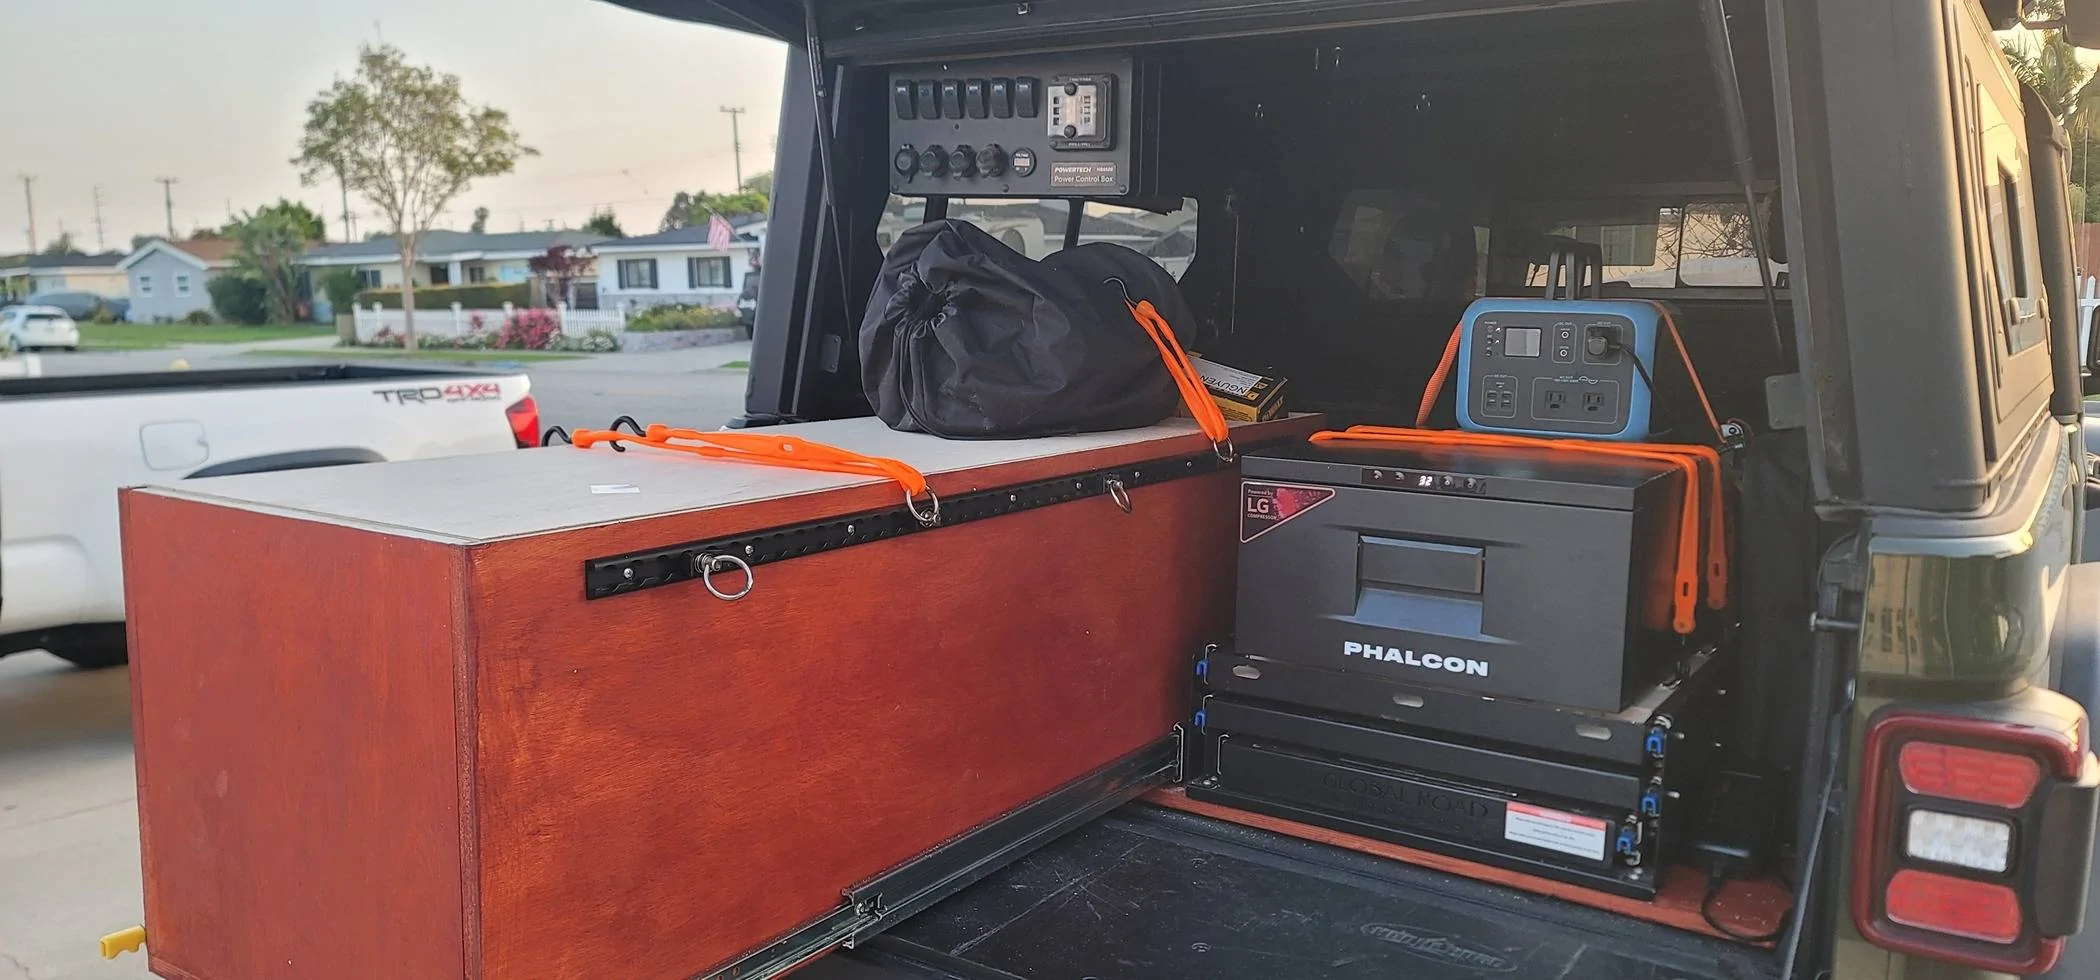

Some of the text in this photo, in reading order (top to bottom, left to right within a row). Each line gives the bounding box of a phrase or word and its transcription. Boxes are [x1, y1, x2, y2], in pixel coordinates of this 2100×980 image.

[1054, 175, 1114, 183] Power Control Box
[1200, 375, 1248, 395] NGUYEN
[373, 387, 442, 405] TRD
[1247, 497, 1269, 513] LG
[1343, 640, 1490, 677] PHALCON
[1321, 773, 1411, 805] GLOBAL
[1417, 790, 1489, 818] ROAD
